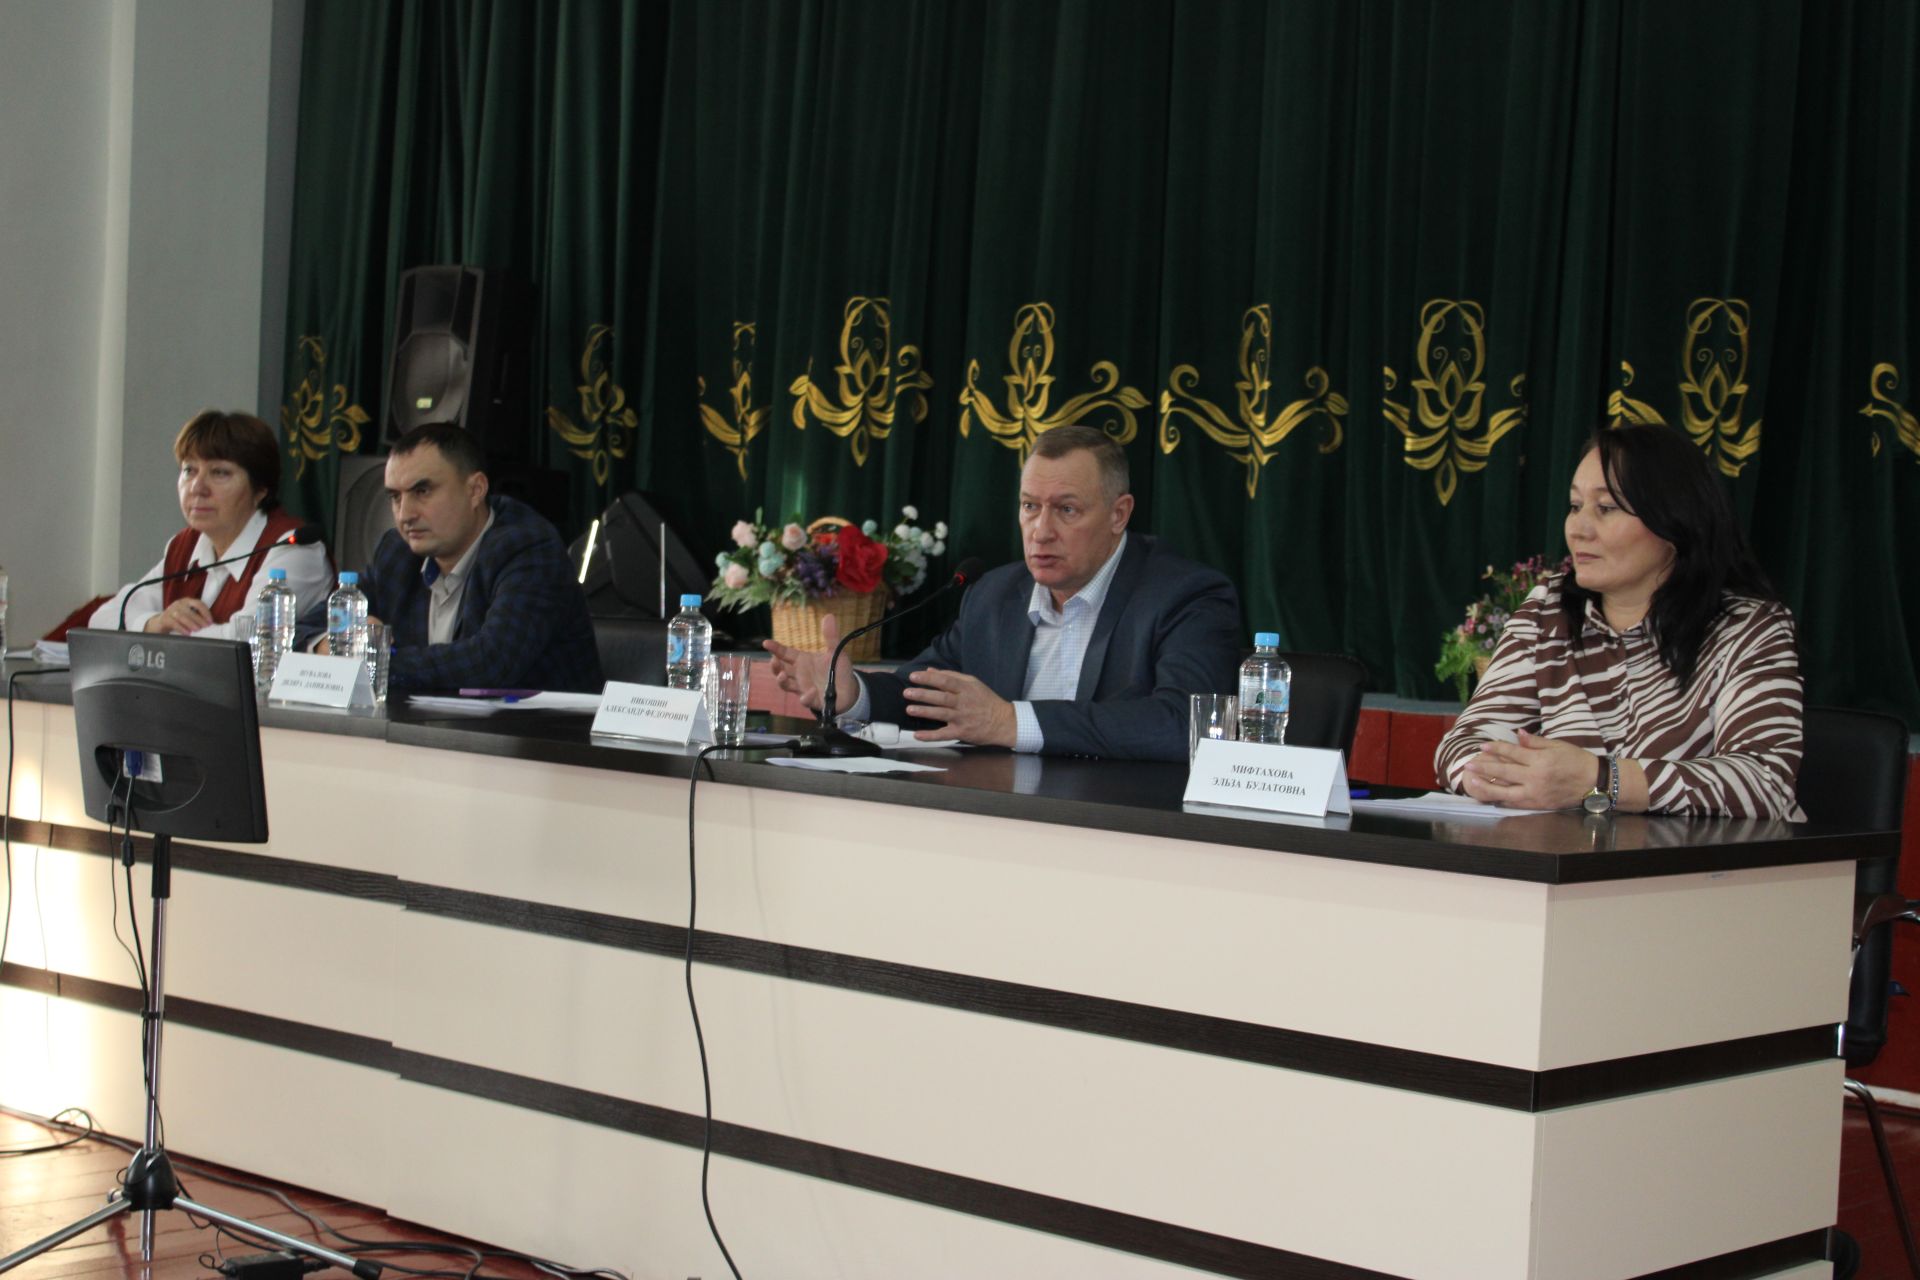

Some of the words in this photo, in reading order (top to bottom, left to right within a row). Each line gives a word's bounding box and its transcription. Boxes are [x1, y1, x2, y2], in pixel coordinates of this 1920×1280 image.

[147, 650, 166, 669] LG
[630, 696, 668, 708] НИКОШИН
[604, 704, 644, 716] АЛЕКСАНДР
[645, 708, 689, 721] ФЕДОРОВИЧ
[1231, 764, 1294, 779] МИФТАХОВА
[1212, 777, 1242, 788] ЭЛЬЗА
[1245, 781, 1306, 796] БУЛАТОВНА
